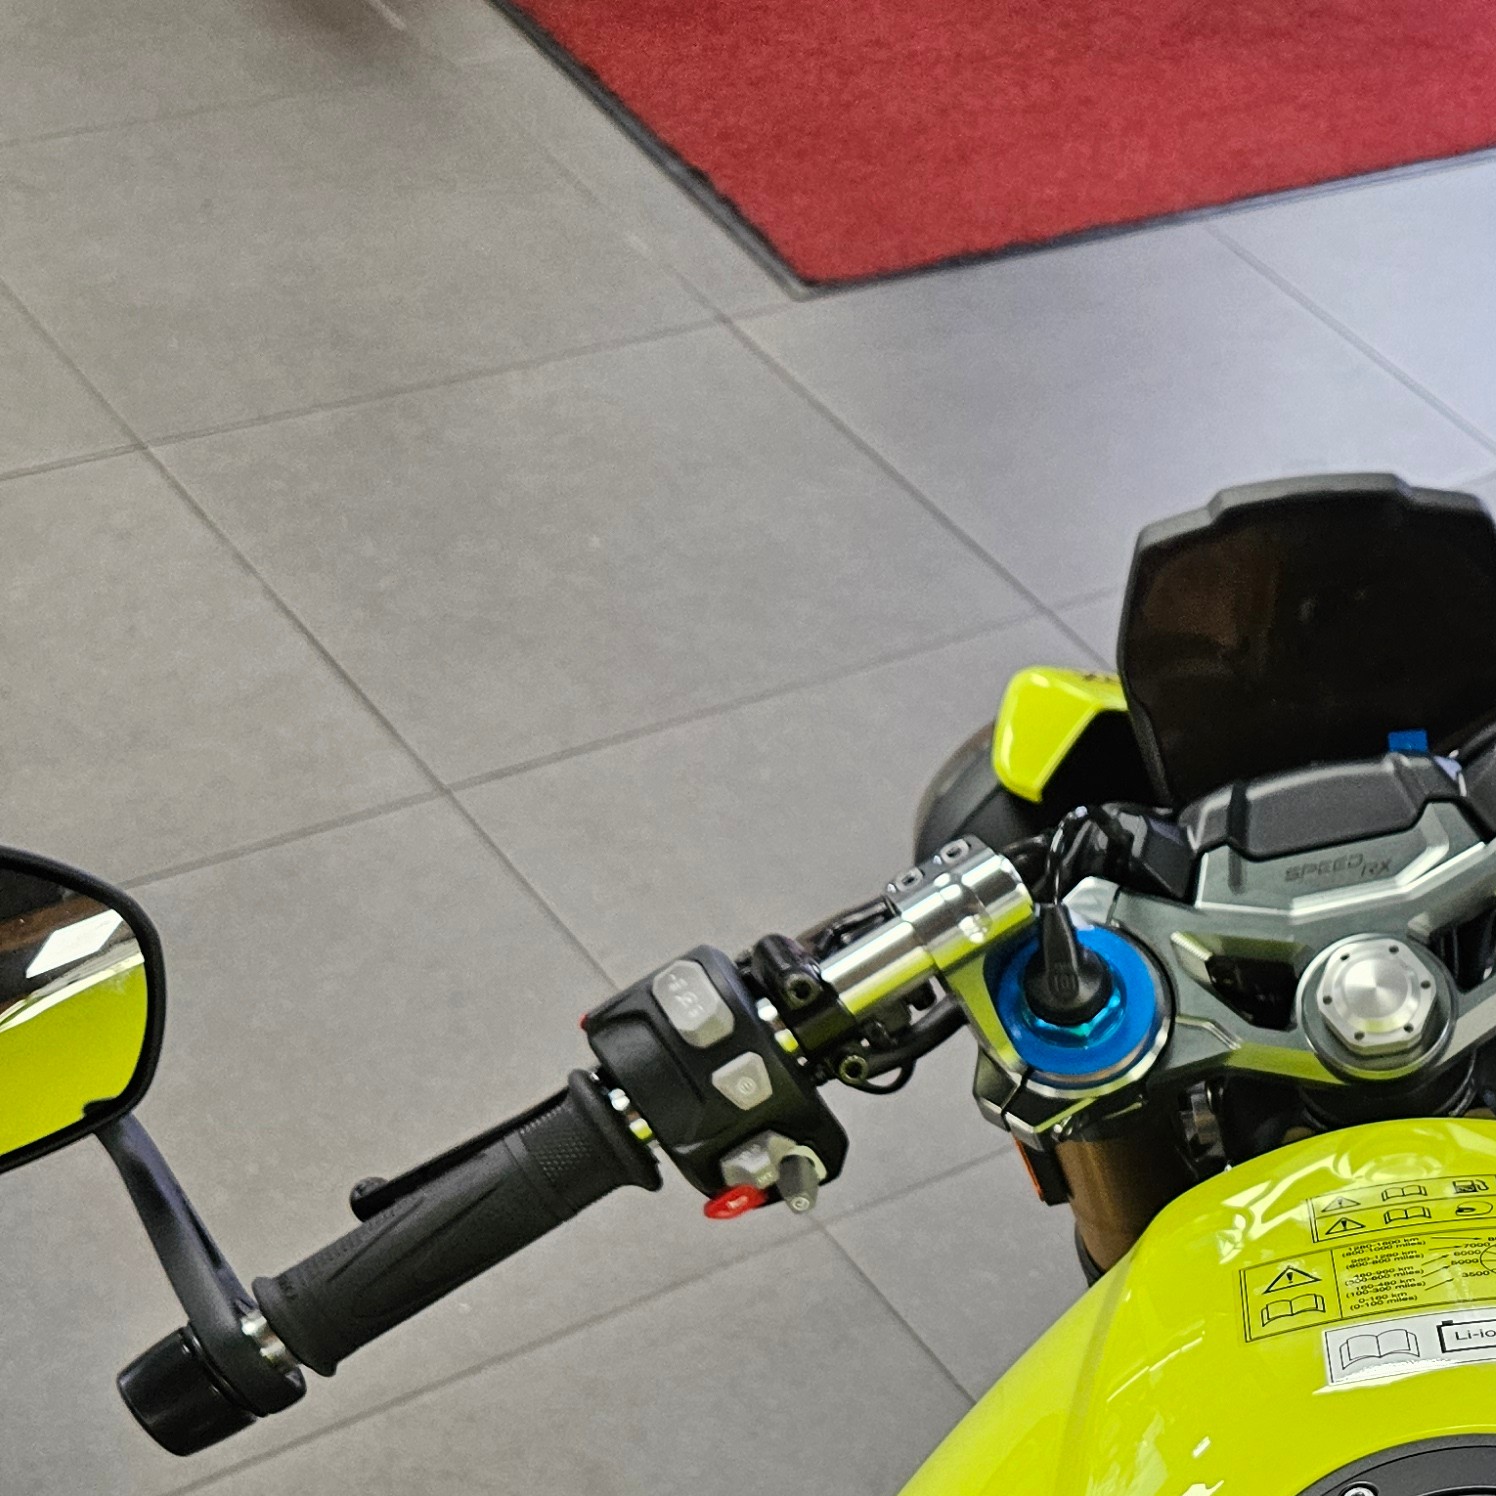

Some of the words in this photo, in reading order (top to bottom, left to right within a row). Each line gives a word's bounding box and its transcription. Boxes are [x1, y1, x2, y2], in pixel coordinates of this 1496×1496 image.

[1285, 854, 1364, 882] SPEED
[1342, 1245, 1393, 1258] (800-1000
[1396, 1240, 1426, 1248] miles)
[1394, 1254, 1424, 1262] miles)
[1394, 1269, 1424, 1277] miles)
[1462, 1270, 1490, 1278] 3500
[1395, 1281, 1426, 1289] miles)
[1350, 1300, 1384, 1311] (0-100
[1387, 1295, 1418, 1303] miles)
